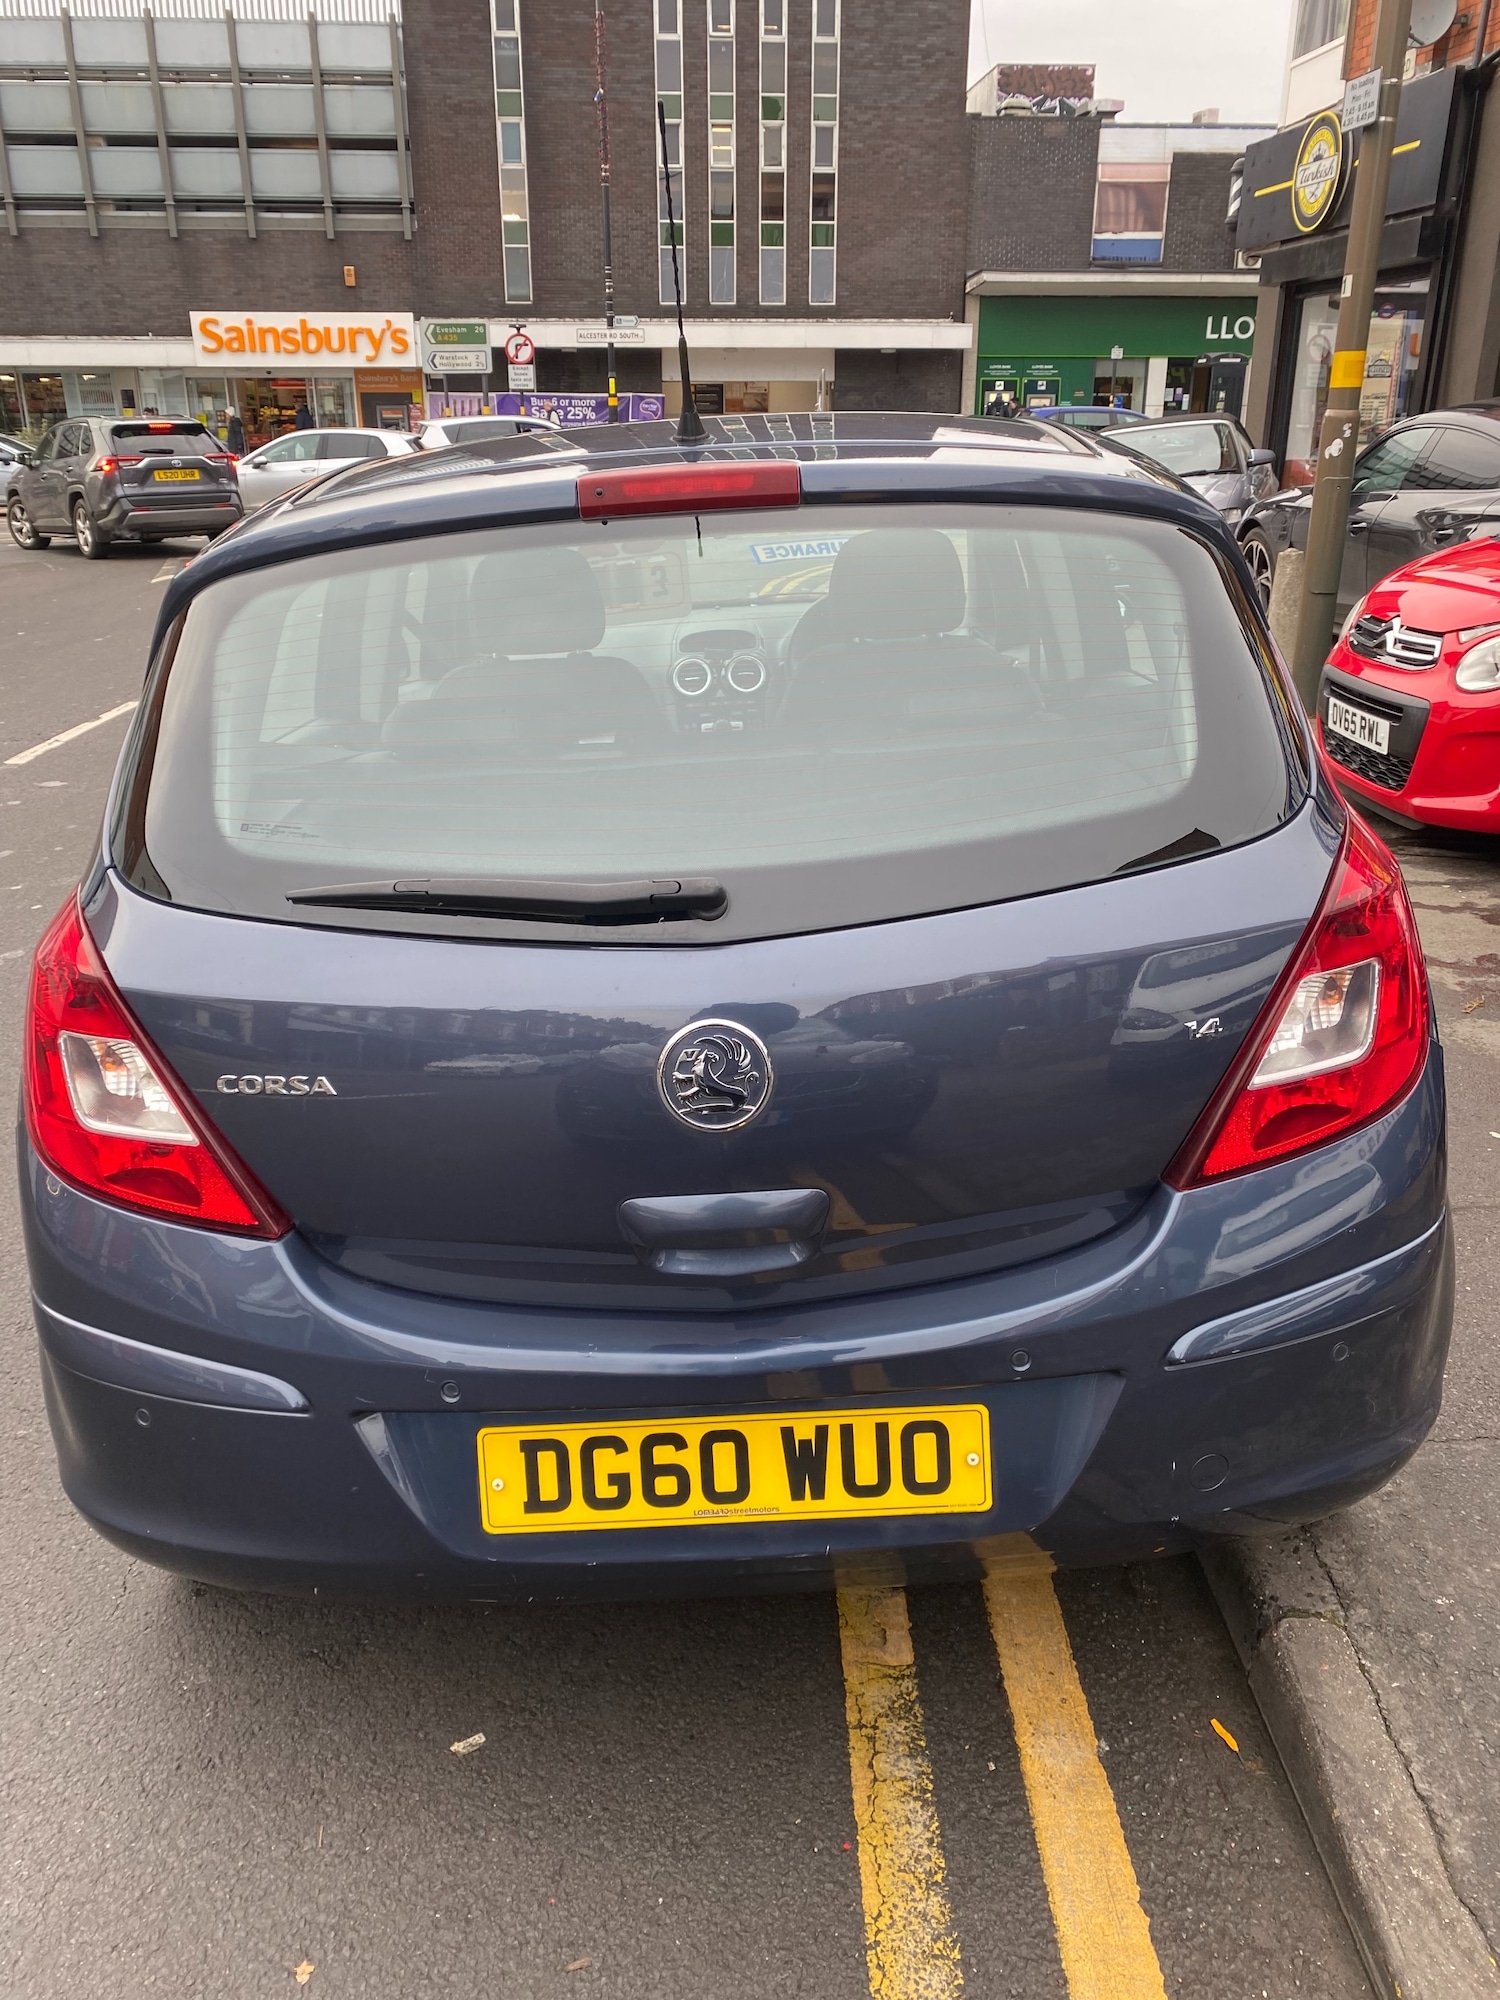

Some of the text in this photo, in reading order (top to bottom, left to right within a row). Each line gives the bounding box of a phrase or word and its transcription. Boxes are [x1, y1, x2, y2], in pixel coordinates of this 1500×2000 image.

[1358, 76, 1375, 88] loading
[1300, 158, 1335, 185] Turkish
[474, 326, 484, 334] 26
[1206, 316, 1255, 340] LLO
[199, 317, 409, 362] Sainsbury's
[439, 361, 472, 369] Hollywood
[358, 374, 418, 384] Sainsbury's Bank
[552, 396, 558, 406] 6
[531, 406, 596, 420] Sae 25%
[157, 470, 196, 480] LS20 UHR
[1332, 702, 1382, 747] OV65 RWL
[216, 1074, 338, 1096] CORSA
[519, 1420, 952, 1514] DG60 WUO
